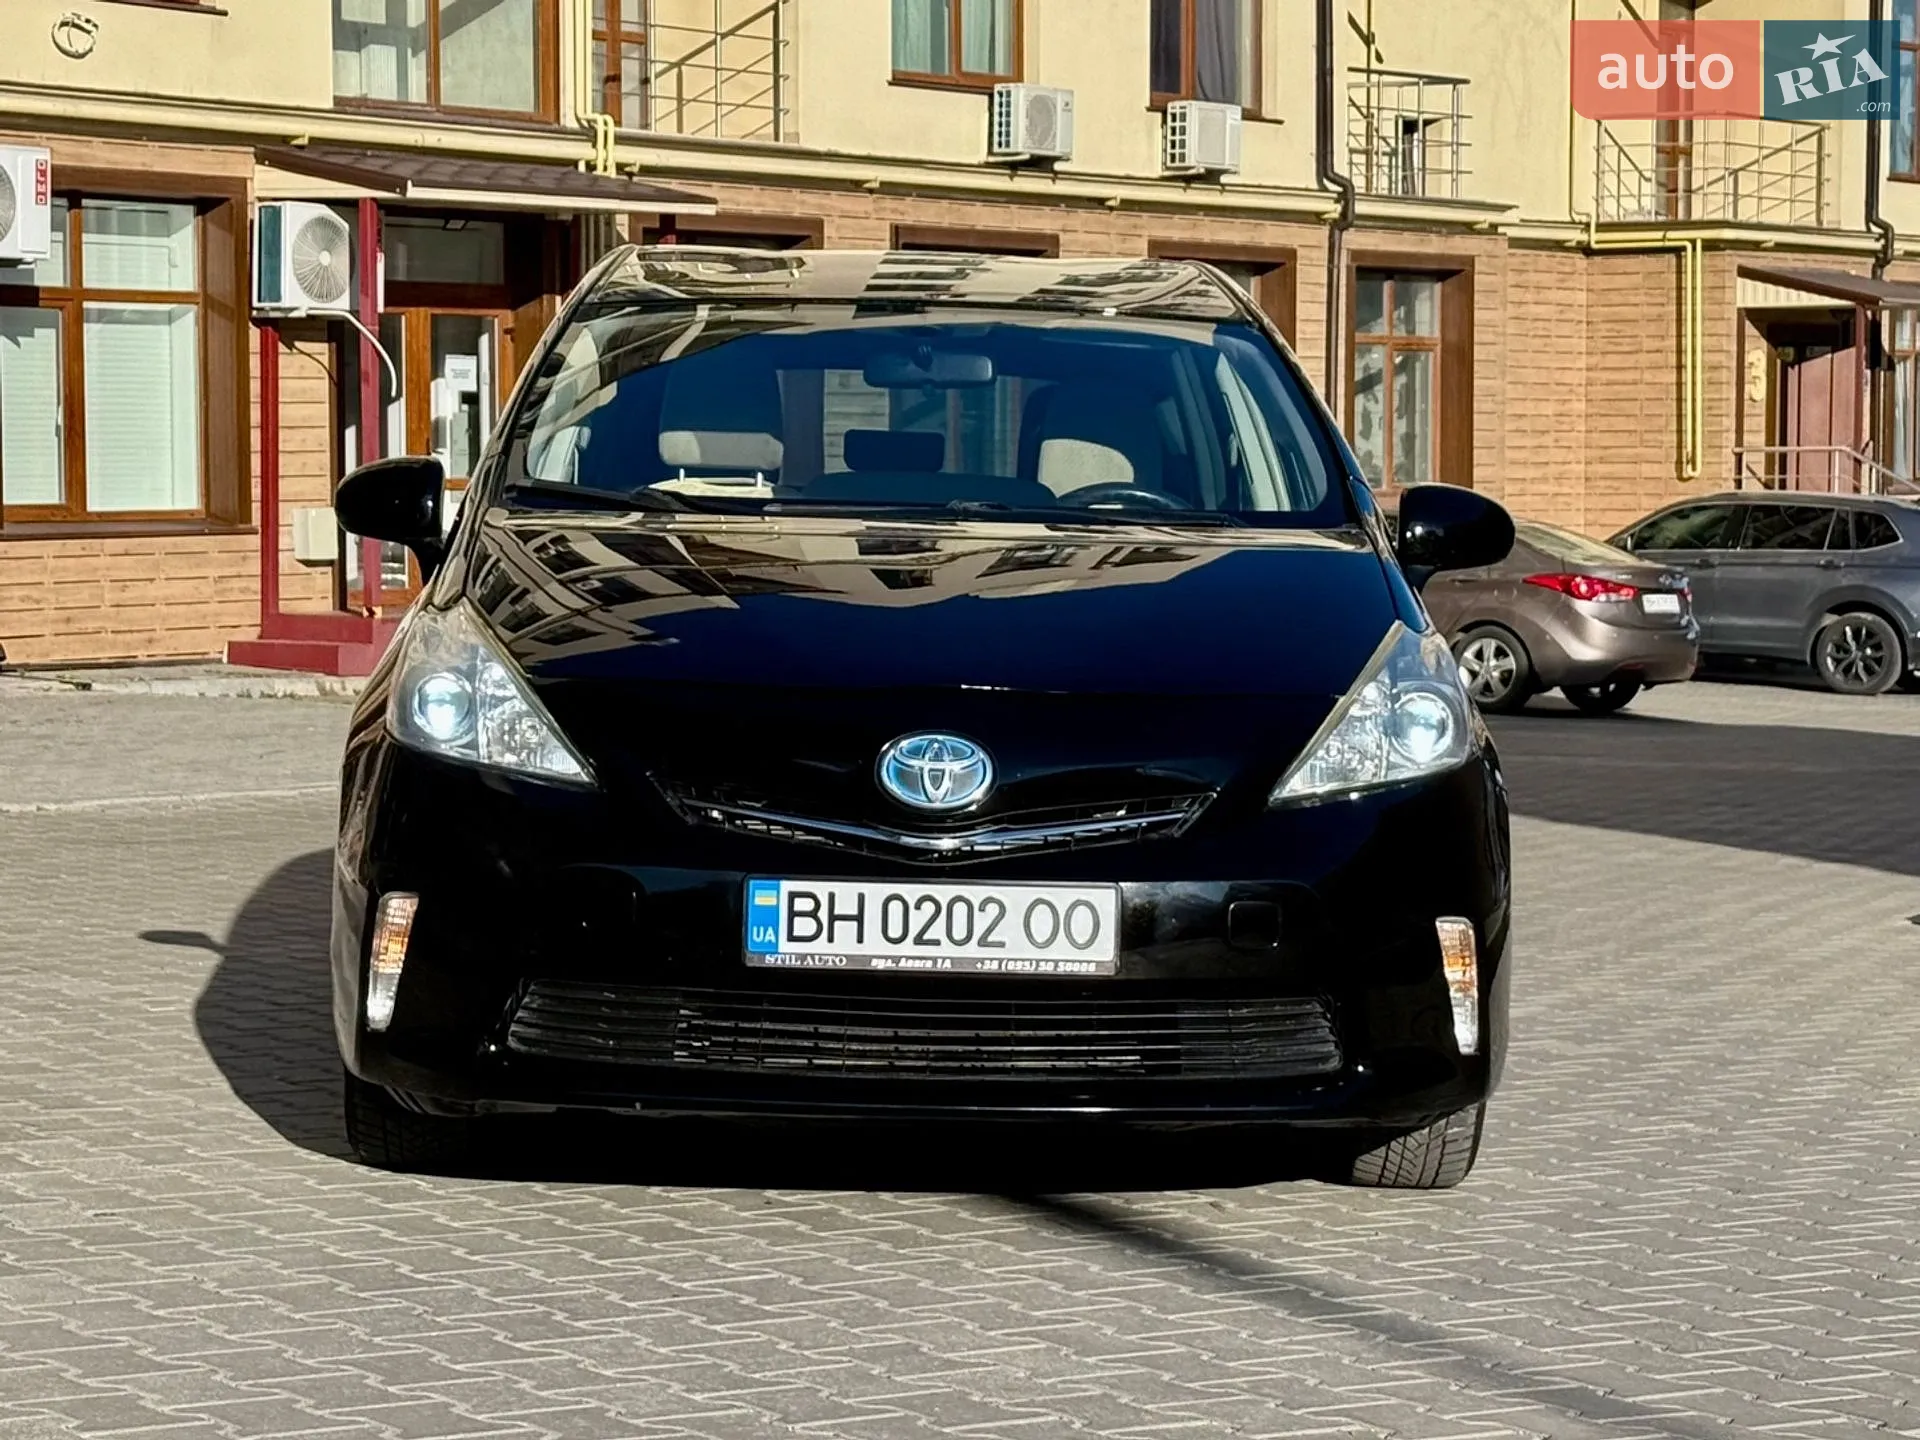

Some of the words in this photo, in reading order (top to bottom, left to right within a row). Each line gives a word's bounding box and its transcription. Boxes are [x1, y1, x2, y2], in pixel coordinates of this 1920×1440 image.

[787, 890, 865, 944] BH
[881, 893, 1007, 948] 0202
[752, 926, 776, 943] UA
[765, 953, 801, 965] STIL
[804, 955, 847, 966] AUTO
